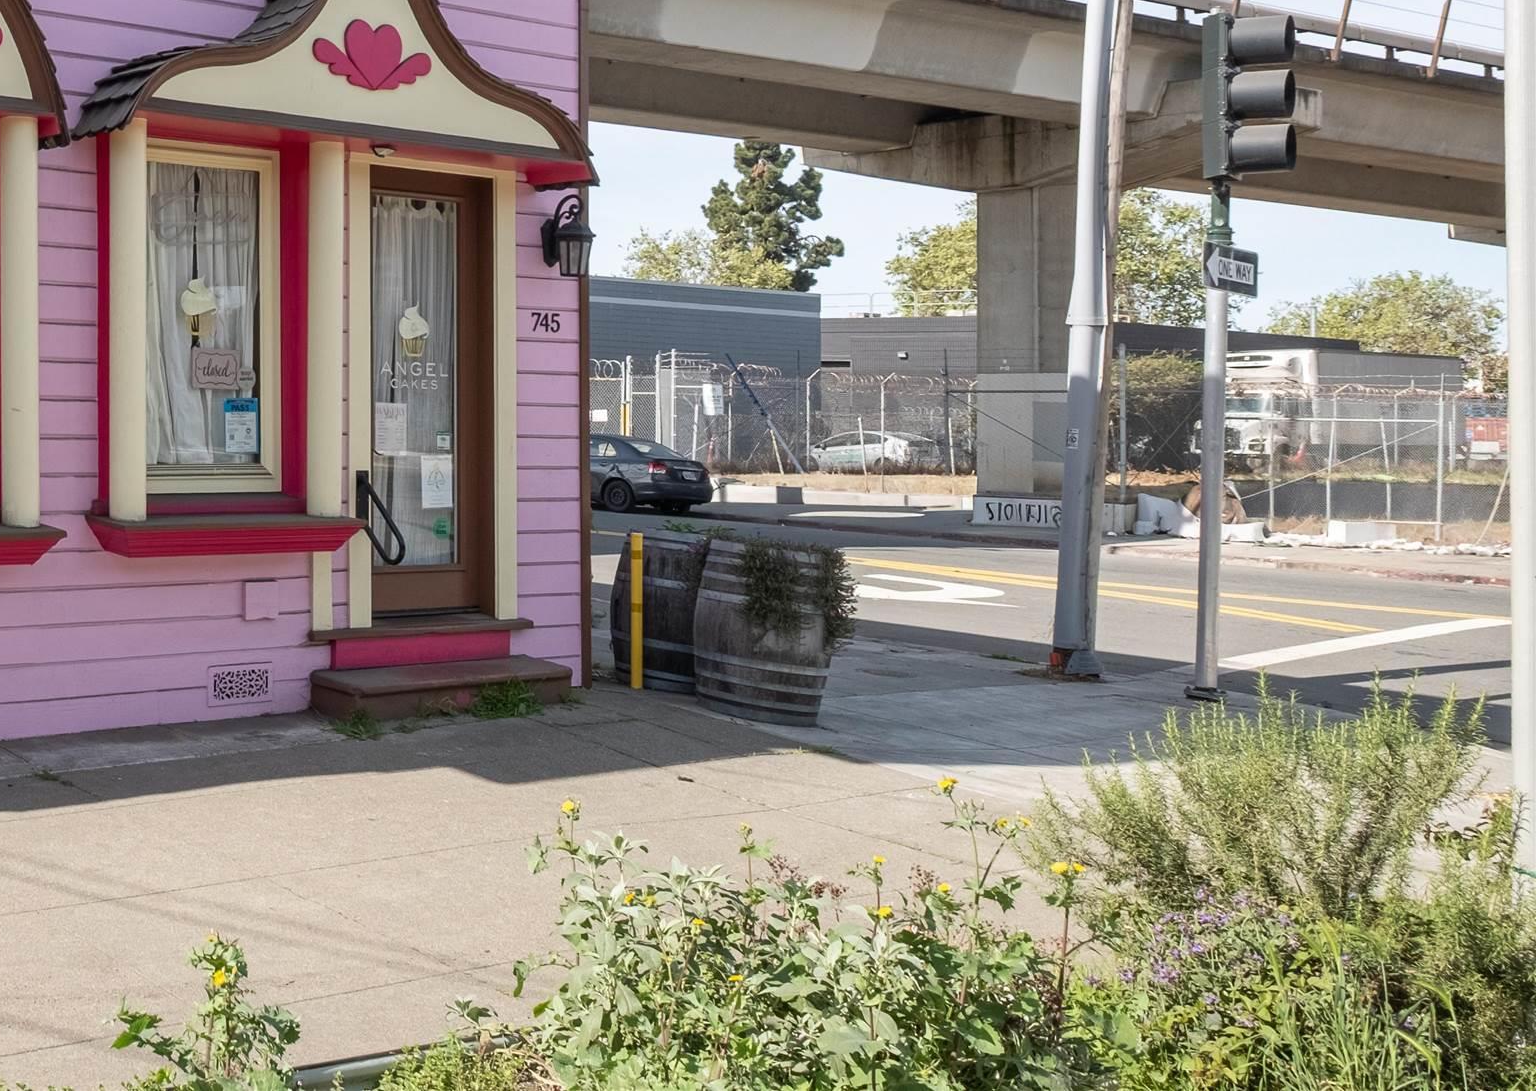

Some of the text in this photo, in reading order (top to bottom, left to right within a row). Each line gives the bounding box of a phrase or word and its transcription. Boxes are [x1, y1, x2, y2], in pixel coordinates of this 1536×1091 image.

[1218, 259, 1253, 282] ONE WAY
[531, 312, 561, 333] 745
[380, 361, 449, 378] ANGEL
[390, 378, 439, 390] CAKES
[231, 404, 250, 412] PASS
